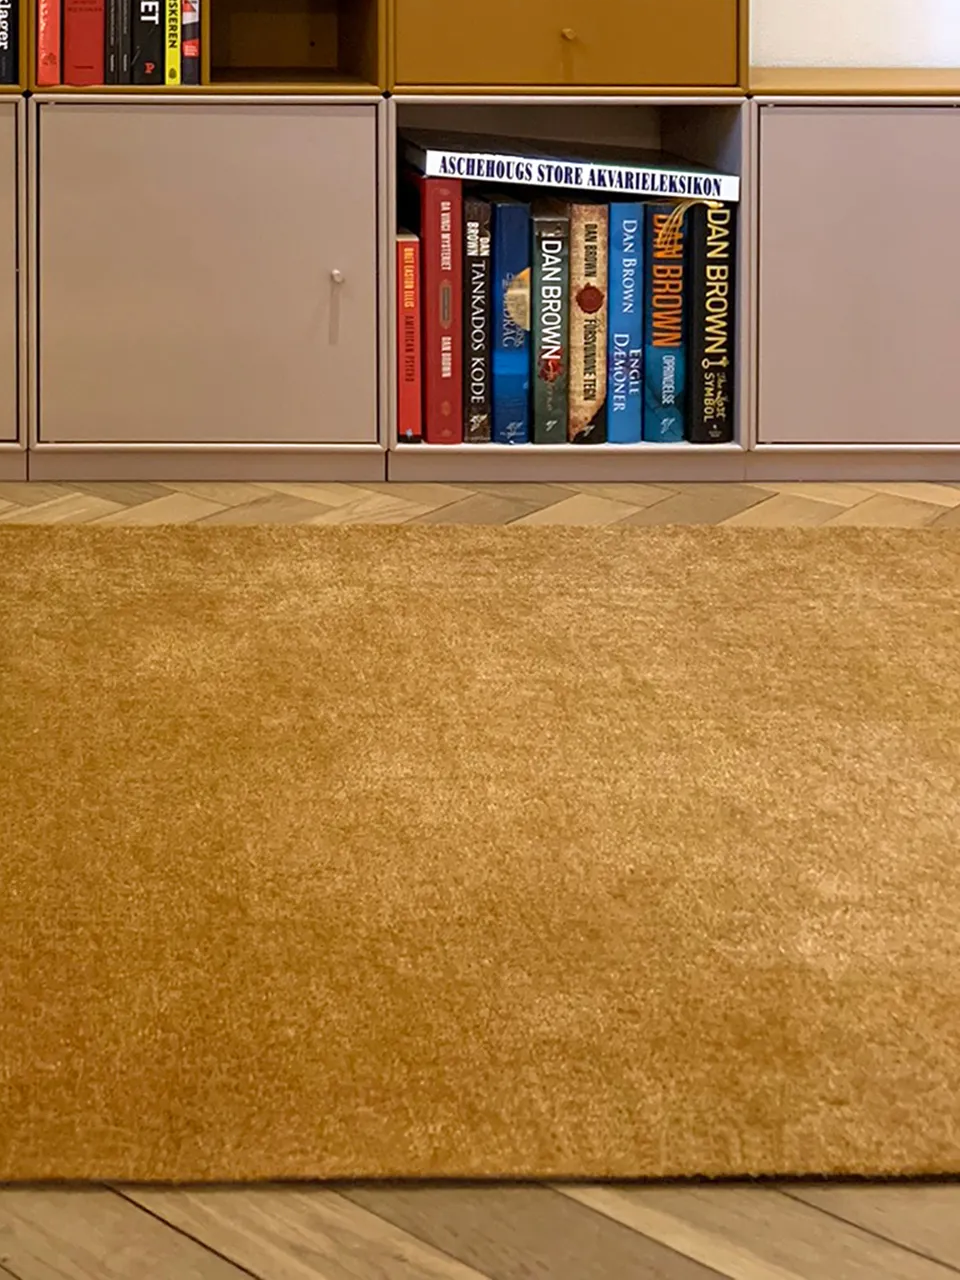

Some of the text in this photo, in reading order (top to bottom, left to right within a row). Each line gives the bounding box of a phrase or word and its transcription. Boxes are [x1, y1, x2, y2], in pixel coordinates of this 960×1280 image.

[439, 156, 722, 197] ASCHEHOUGS STORE AKVARIELEKSIKON
[440, 233, 451, 270] MYSTERIET
[467, 221, 479, 256] BROWN
[480, 236, 490, 256] DAN
[584, 223, 597, 277] DAN BROWN
[541, 239, 562, 359] DAN BROWN
[652, 214, 684, 347] DAN BROWN
[705, 209, 730, 353] DAN BROWN
[404, 315, 415, 352] AMERICAN
[471, 260, 486, 404] TANKADOS KODE
[404, 355, 415, 382] PSYCHO
[583, 378, 597, 402] TEGN
[613, 333, 630, 412] DÆMONER
[662, 355, 675, 405] OPRINDELSE
[704, 372, 715, 423] SYMBOL
